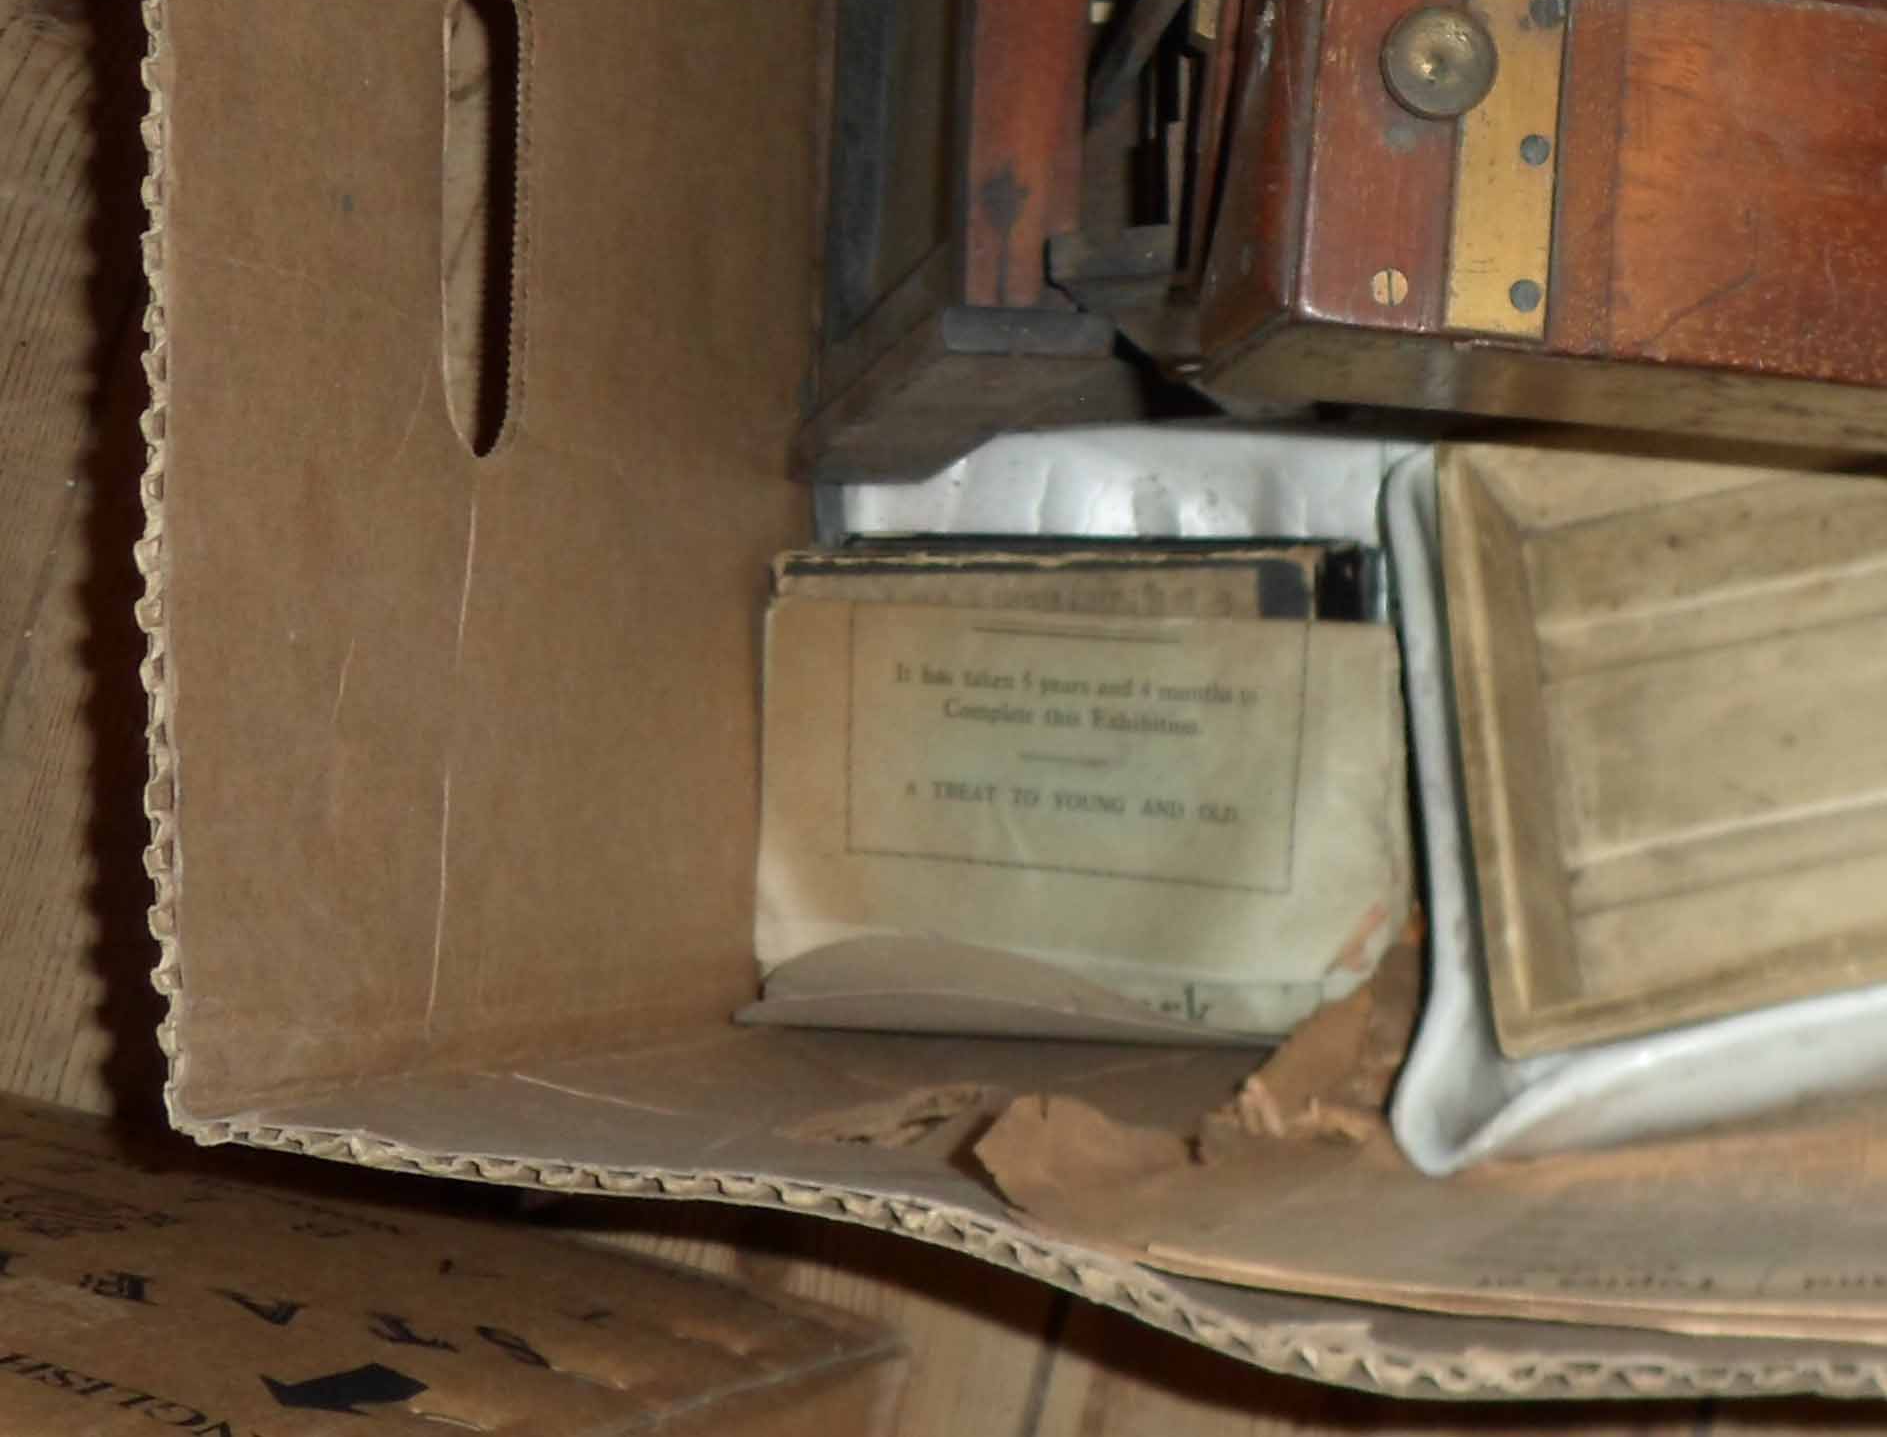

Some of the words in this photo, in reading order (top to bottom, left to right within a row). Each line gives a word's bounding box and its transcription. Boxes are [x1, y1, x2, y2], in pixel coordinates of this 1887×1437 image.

[895, 662, 911, 683] It
[921, 666, 953, 685] has
[963, 670, 1015, 690] taken
[1039, 676, 1090, 699] years
[1097, 677, 1133, 698] and
[1157, 682, 1234, 705] months
[942, 697, 1034, 726] Complete
[1042, 708, 1081, 729] this
[931, 780, 998, 804] TREAT
[1010, 786, 1040, 808] TO
[1052, 790, 1126, 817] YOUNG
[1140, 797, 1186, 821] AND
